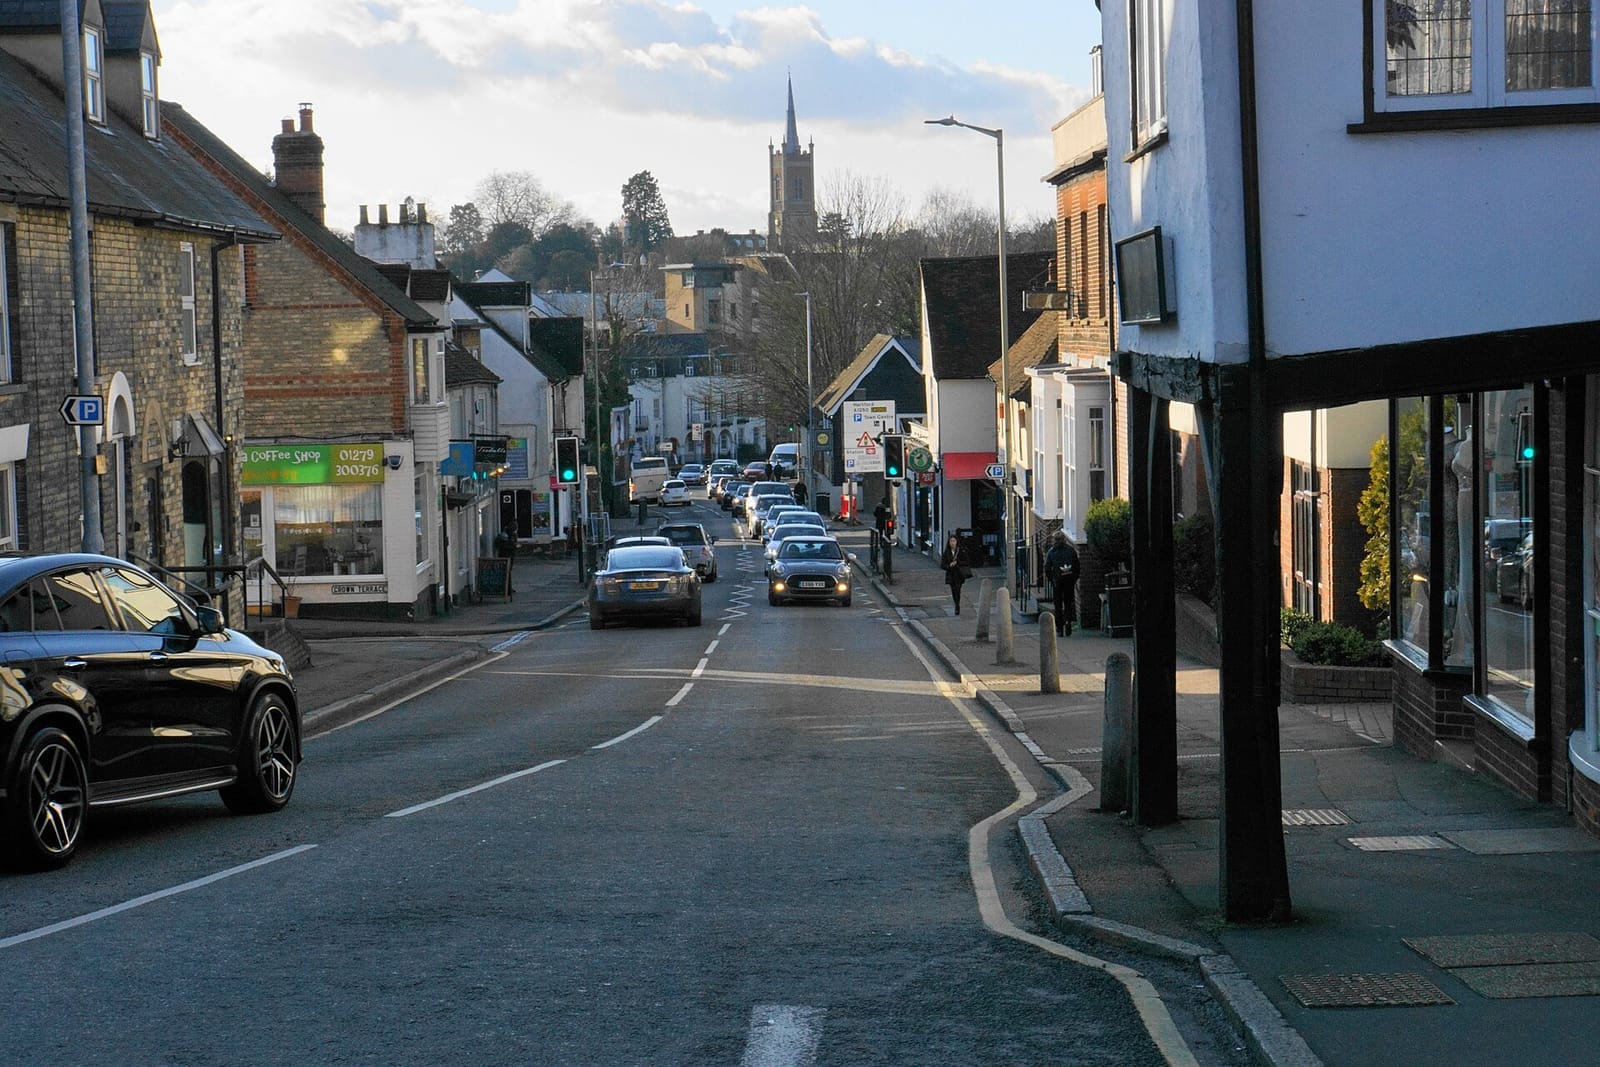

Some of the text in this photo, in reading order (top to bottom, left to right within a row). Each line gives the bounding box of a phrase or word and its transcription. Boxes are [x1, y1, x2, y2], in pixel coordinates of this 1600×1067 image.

[84, 402, 96, 419] P
[339, 449, 374, 462] 01279
[336, 464, 379, 477] 300376
[995, 467, 1001, 475] P
